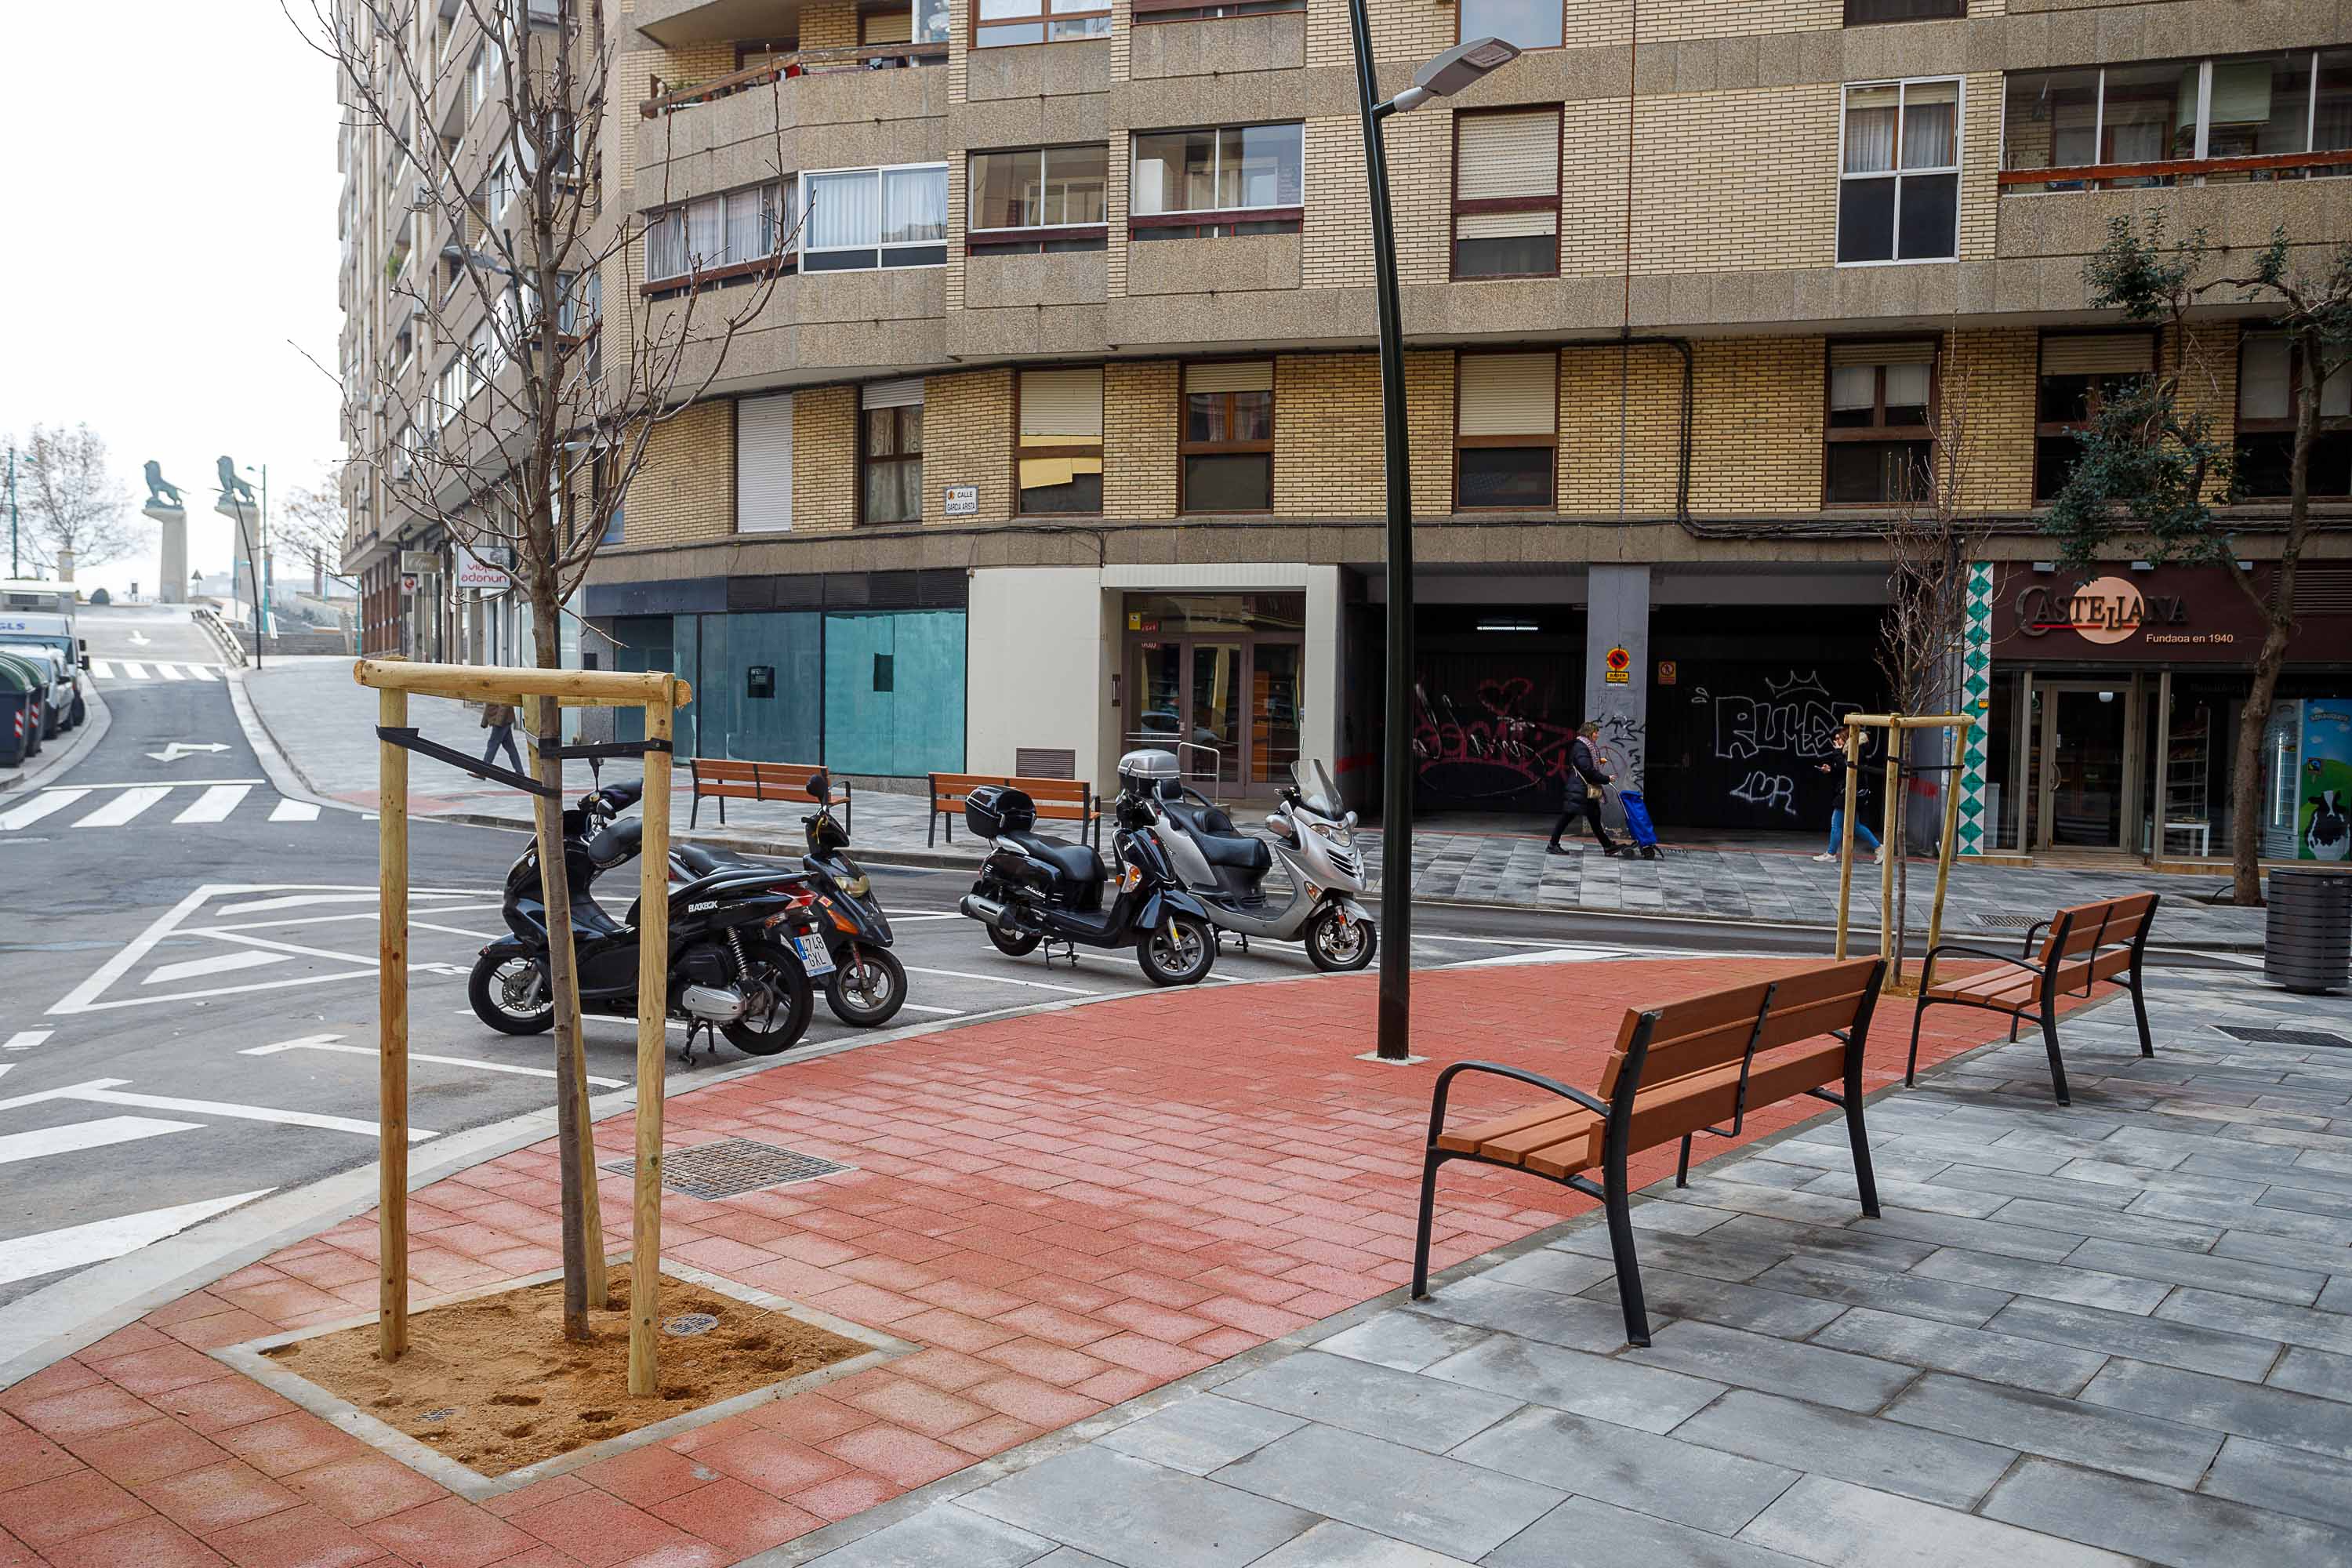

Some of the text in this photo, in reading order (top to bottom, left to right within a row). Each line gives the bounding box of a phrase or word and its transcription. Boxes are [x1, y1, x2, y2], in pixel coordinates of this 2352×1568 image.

[2014, 585, 2190, 637] CASTELLANA
[2146, 633, 2234, 644] Fundada en 1940
[688, 900, 718, 913] BLACKBOX
[801, 936, 825, 953] 4748
[808, 952, 826, 967] GXL
